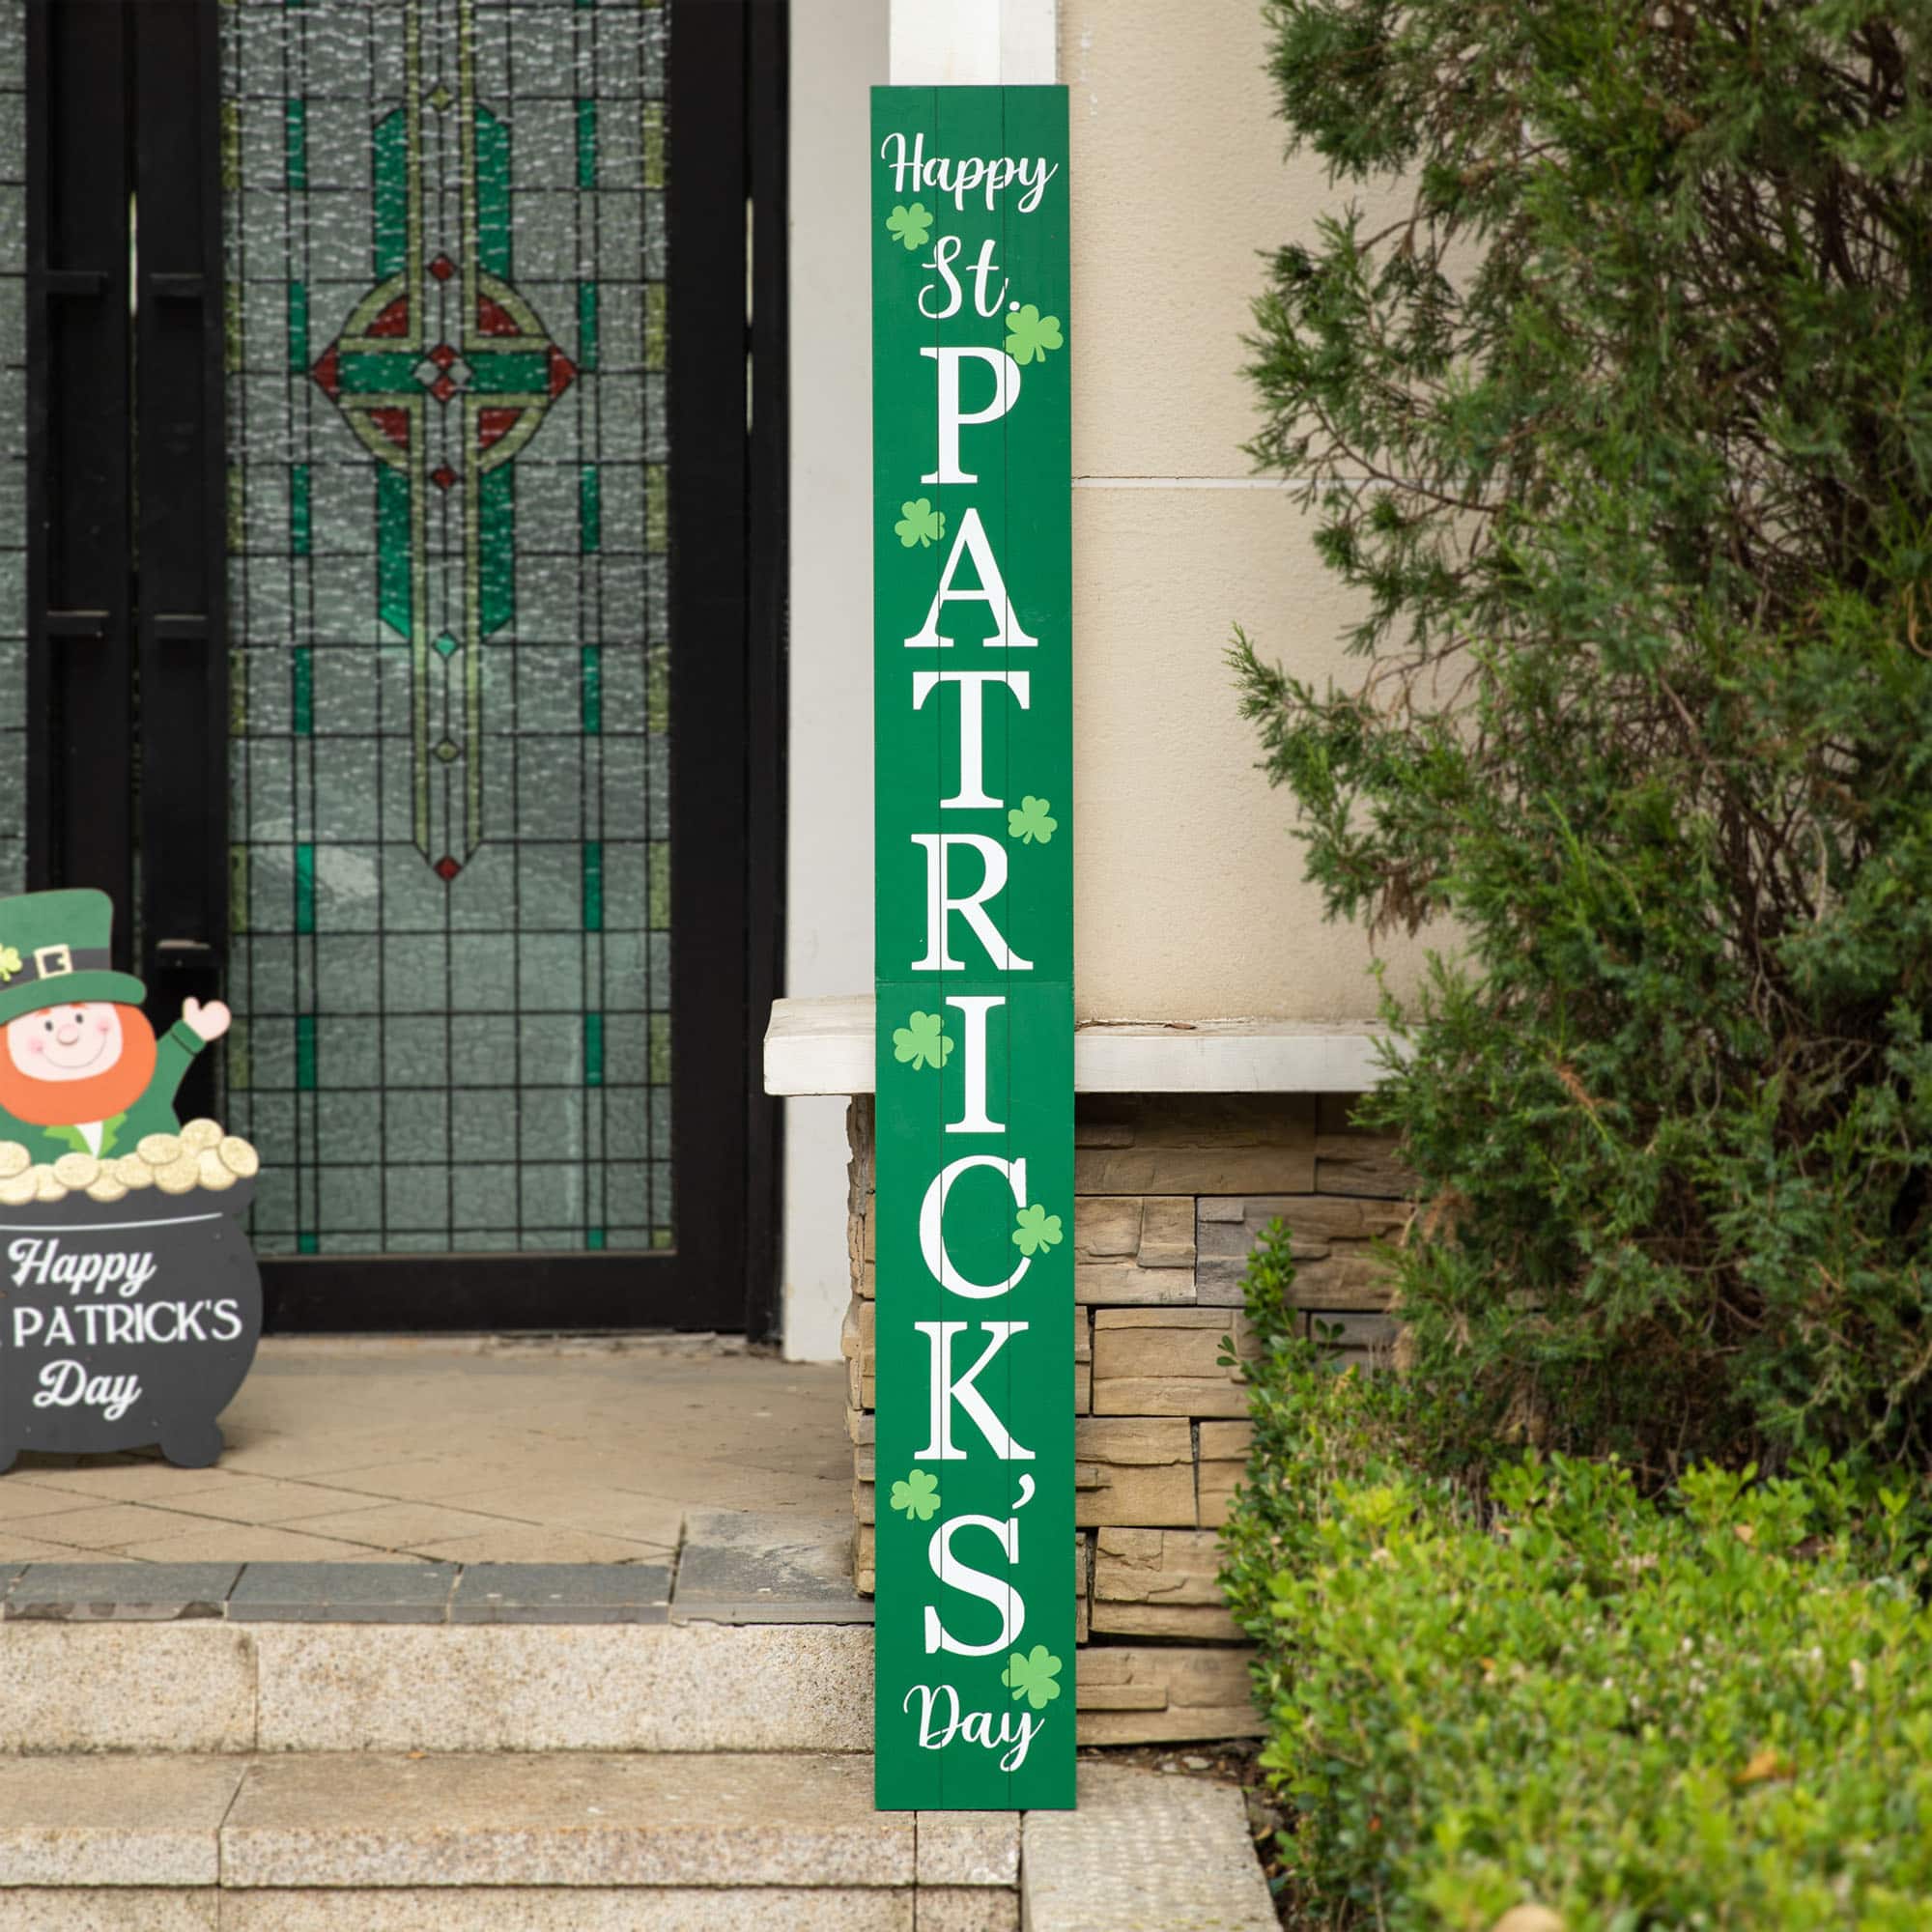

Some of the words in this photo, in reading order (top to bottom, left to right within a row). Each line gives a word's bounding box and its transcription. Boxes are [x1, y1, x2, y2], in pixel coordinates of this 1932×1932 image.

[880, 132, 1059, 213] Happy
[918, 235, 1021, 319] St.
[903, 347, 1038, 1657] PATRICK'S
[8, 1237, 157, 1297] Happy
[14, 1298, 242, 1348] PATRICK'S
[33, 1359, 142, 1420] Day
[903, 1685, 1045, 1772] Day
